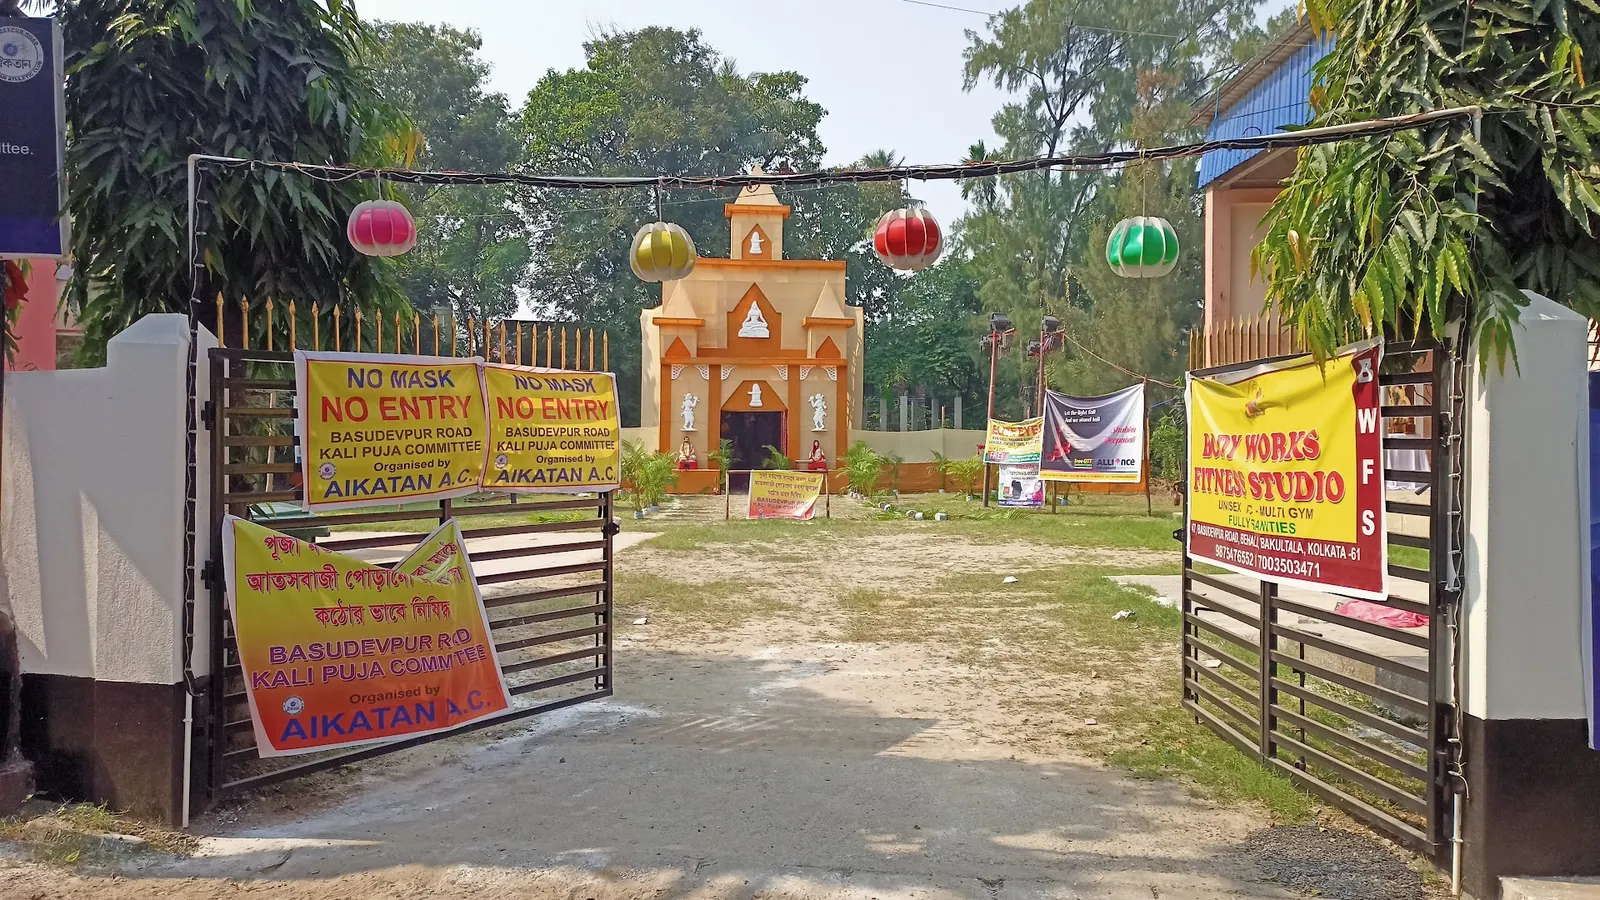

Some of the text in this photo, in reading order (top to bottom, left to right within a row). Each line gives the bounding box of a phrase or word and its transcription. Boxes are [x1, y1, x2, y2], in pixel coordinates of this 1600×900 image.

[348, 368, 455, 388] NO MASK
[513, 374, 596, 393] NO MASK
[321, 395, 471, 422] NO ENTRY
[496, 396, 608, 420] NO ENTRY
[331, 427, 473, 443] BASUDEVPUR ROAD
[505, 427, 610, 437] BASUDEVPUR ROAD
[319, 440, 481, 460] KALI PUJA COMMITTEE
[497, 440, 615, 451] KALI PUJA COMMITTEE
[1245, 429, 1321, 462] WORKS
[373, 458, 451, 473] Organised by
[536, 455, 595, 465] Organised by
[324, 469, 473, 498] AIKATAN A.C.
[495, 466, 616, 483] AIKATAN A.C.
[1193, 466, 1346, 504] FITNESS STUDIO
[1218, 499, 1242, 513] UNISEX
[1288, 508, 1314, 519] GYM
[264, 535, 300, 562] পূজা
[1308, 542, 1347, 559] KOLKATA
[245, 563, 339, 594] আতসবাজী
[313, 598, 365, 627] কঠোর
[368, 601, 408, 624] ভাবে
[269, 633, 433, 665] BASUDEVPUR
[252, 667, 313, 690] KALI
[322, 662, 385, 685] PUJA
[349, 685, 441, 705] Organised by
[280, 702, 436, 742] AIKATAN
[445, 689, 491, 720] A.C.
